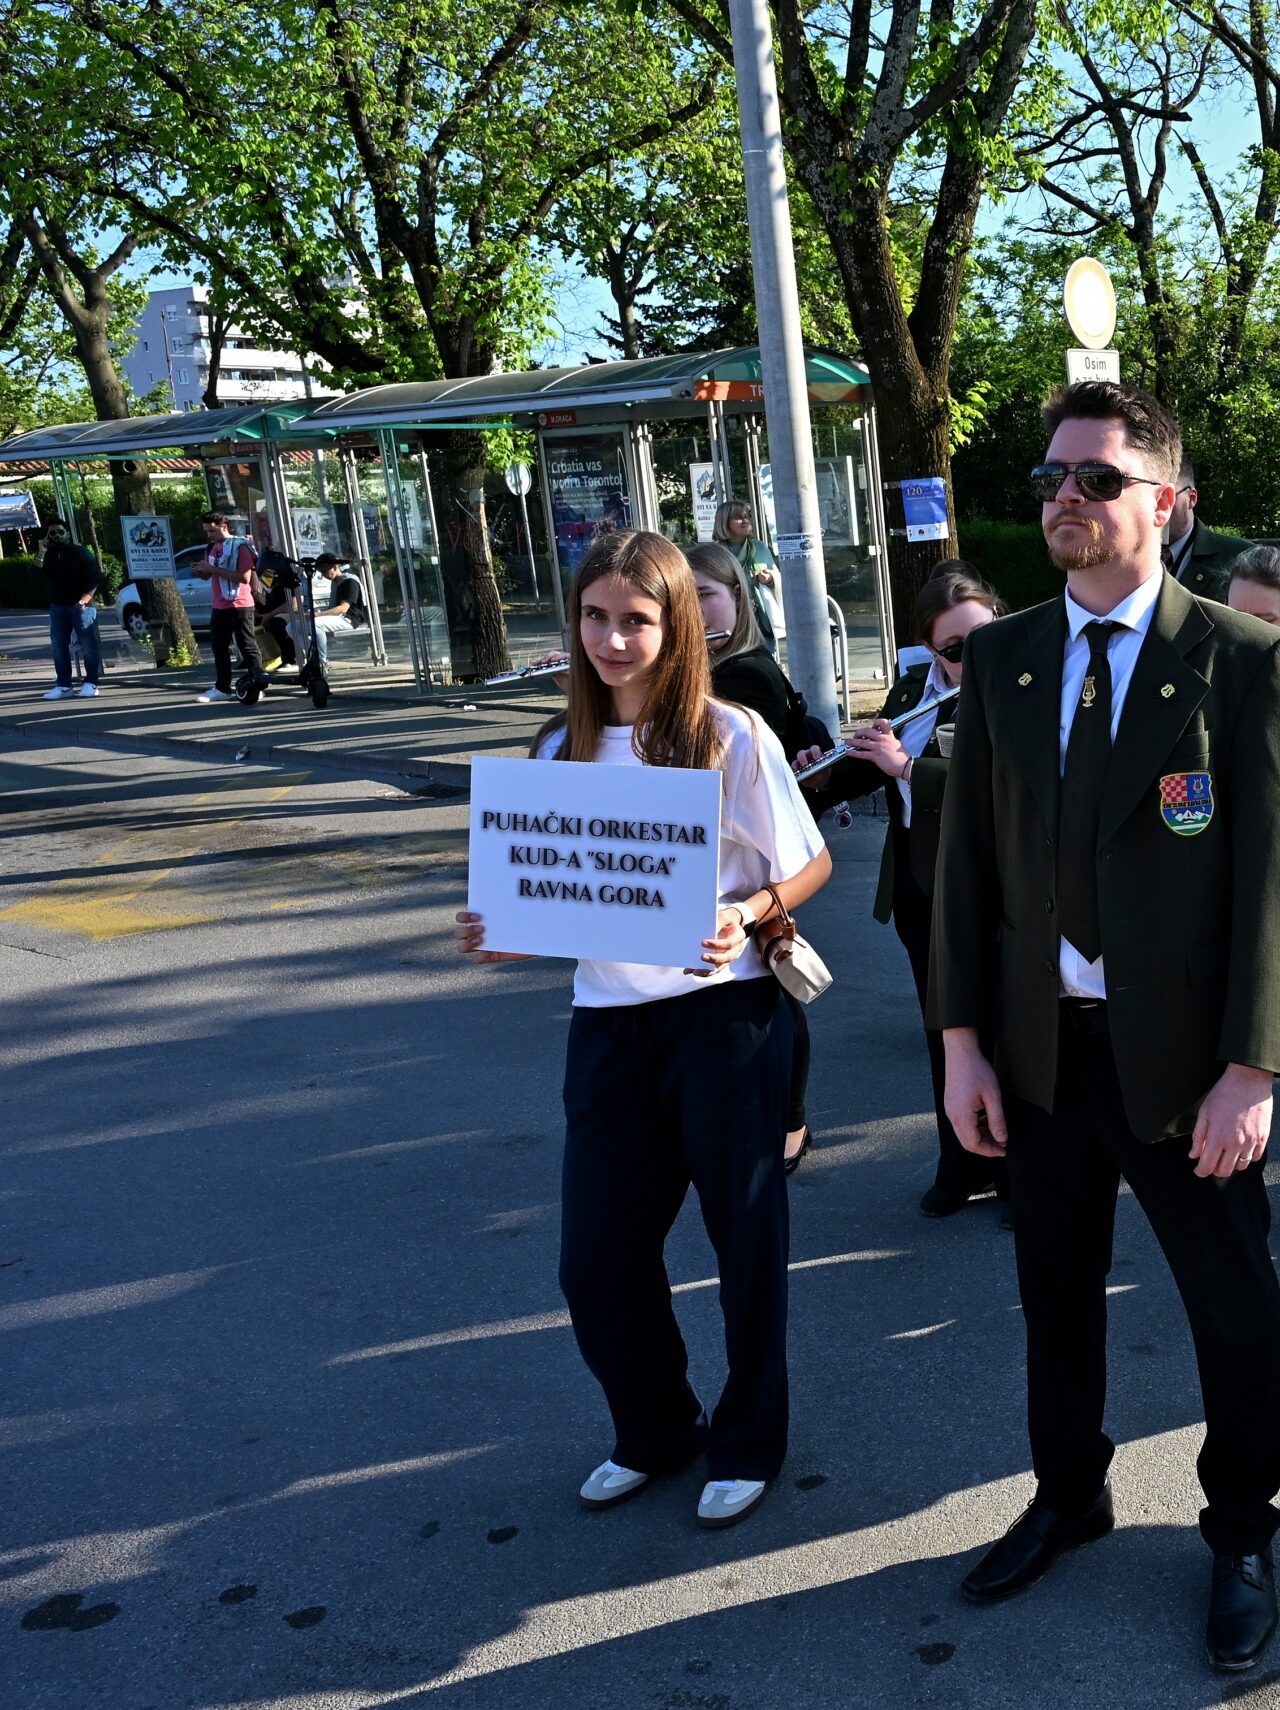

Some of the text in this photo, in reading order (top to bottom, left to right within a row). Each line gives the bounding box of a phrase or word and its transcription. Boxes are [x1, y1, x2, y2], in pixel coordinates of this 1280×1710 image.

[1084, 356, 1107, 371] Osim
[551, 458, 602, 474] Croatia vas
[906, 487, 923, 496] 120
[482, 811, 707, 844] PUHAČKI ORKESTAR
[510, 846, 676, 875] KUD-A "SLOGA"
[519, 878, 665, 908] RAVNA GORA
